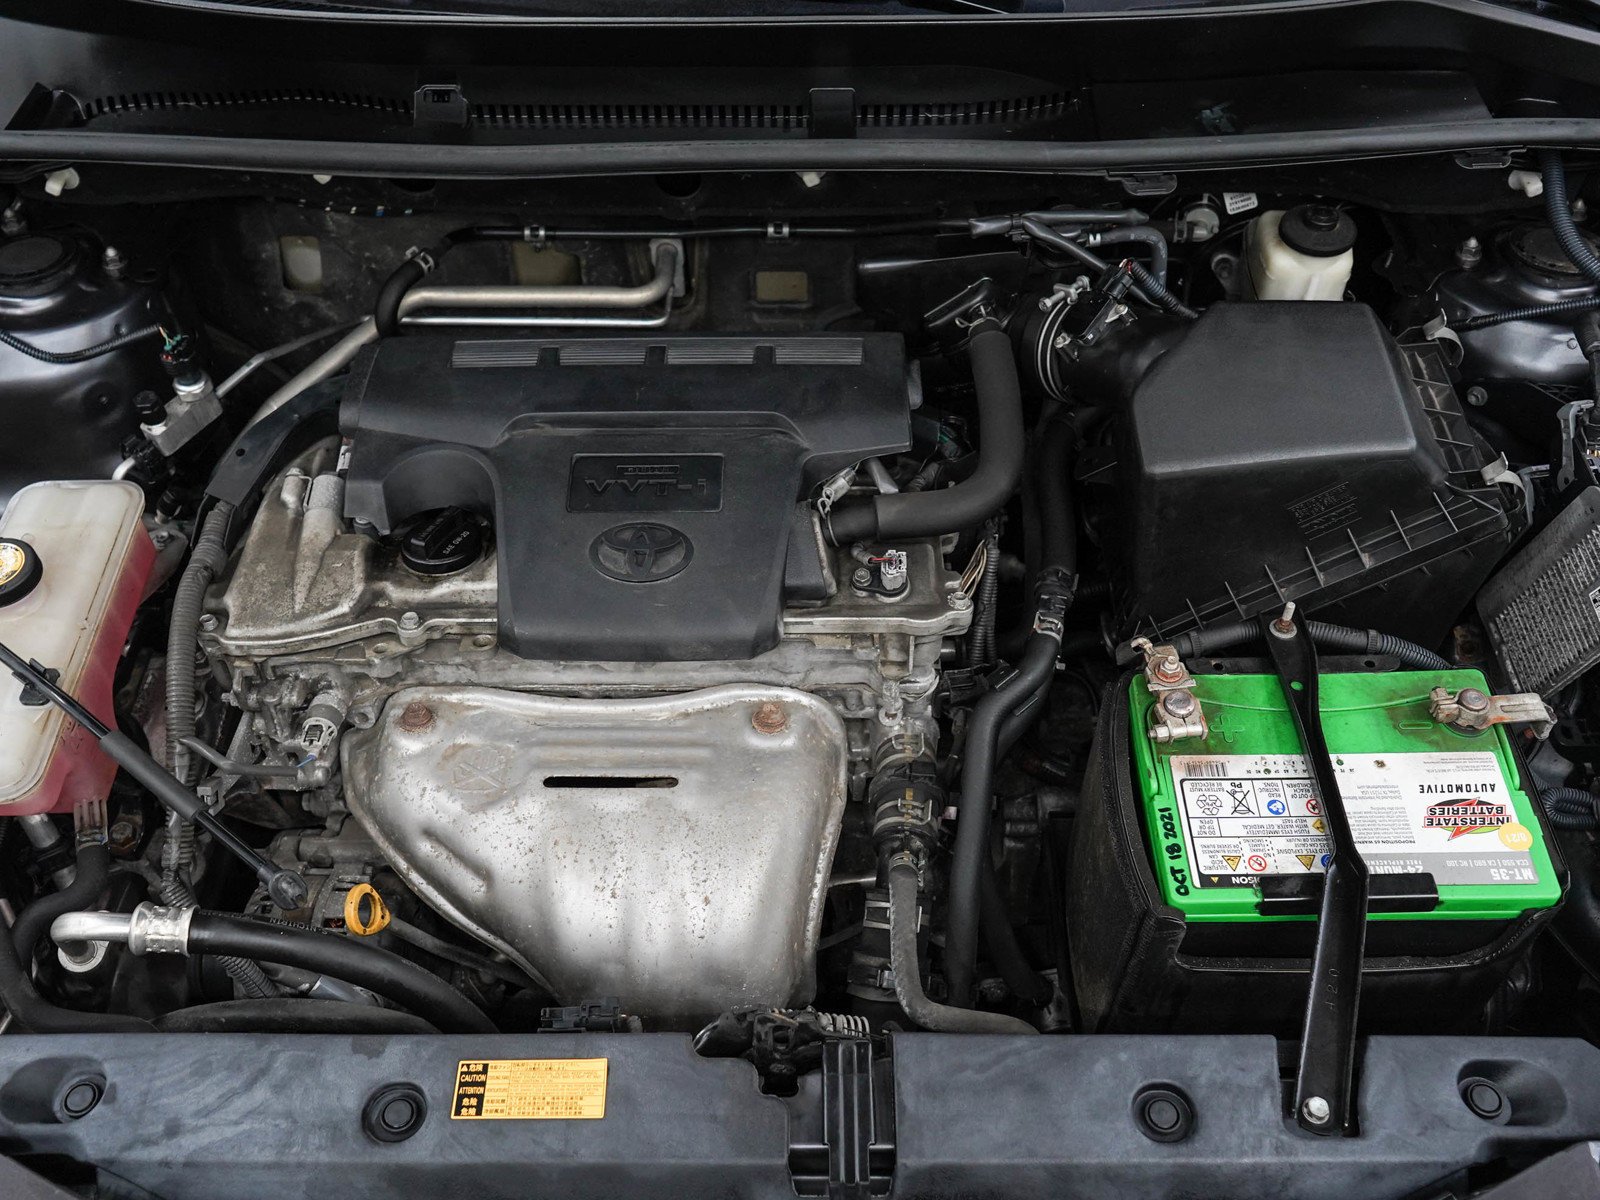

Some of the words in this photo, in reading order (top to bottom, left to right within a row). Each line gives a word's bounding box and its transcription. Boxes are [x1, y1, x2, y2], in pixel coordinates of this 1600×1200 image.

[1419, 784, 1496, 794] AUTOMOTIVE
[1429, 806, 1503, 816] BATTERIES
[1157, 807, 1178, 840] 2021
[1427, 817, 1509, 827] INTERSTATE
[1164, 843, 1182, 860] 18
[1490, 868, 1534, 881] MT-35
[1169, 866, 1190, 896] OCT
[1231, 876, 1260, 884] ISON
[460, 1074, 487, 1082] CAUTION
[458, 1086, 485, 1095] ATTENTION
